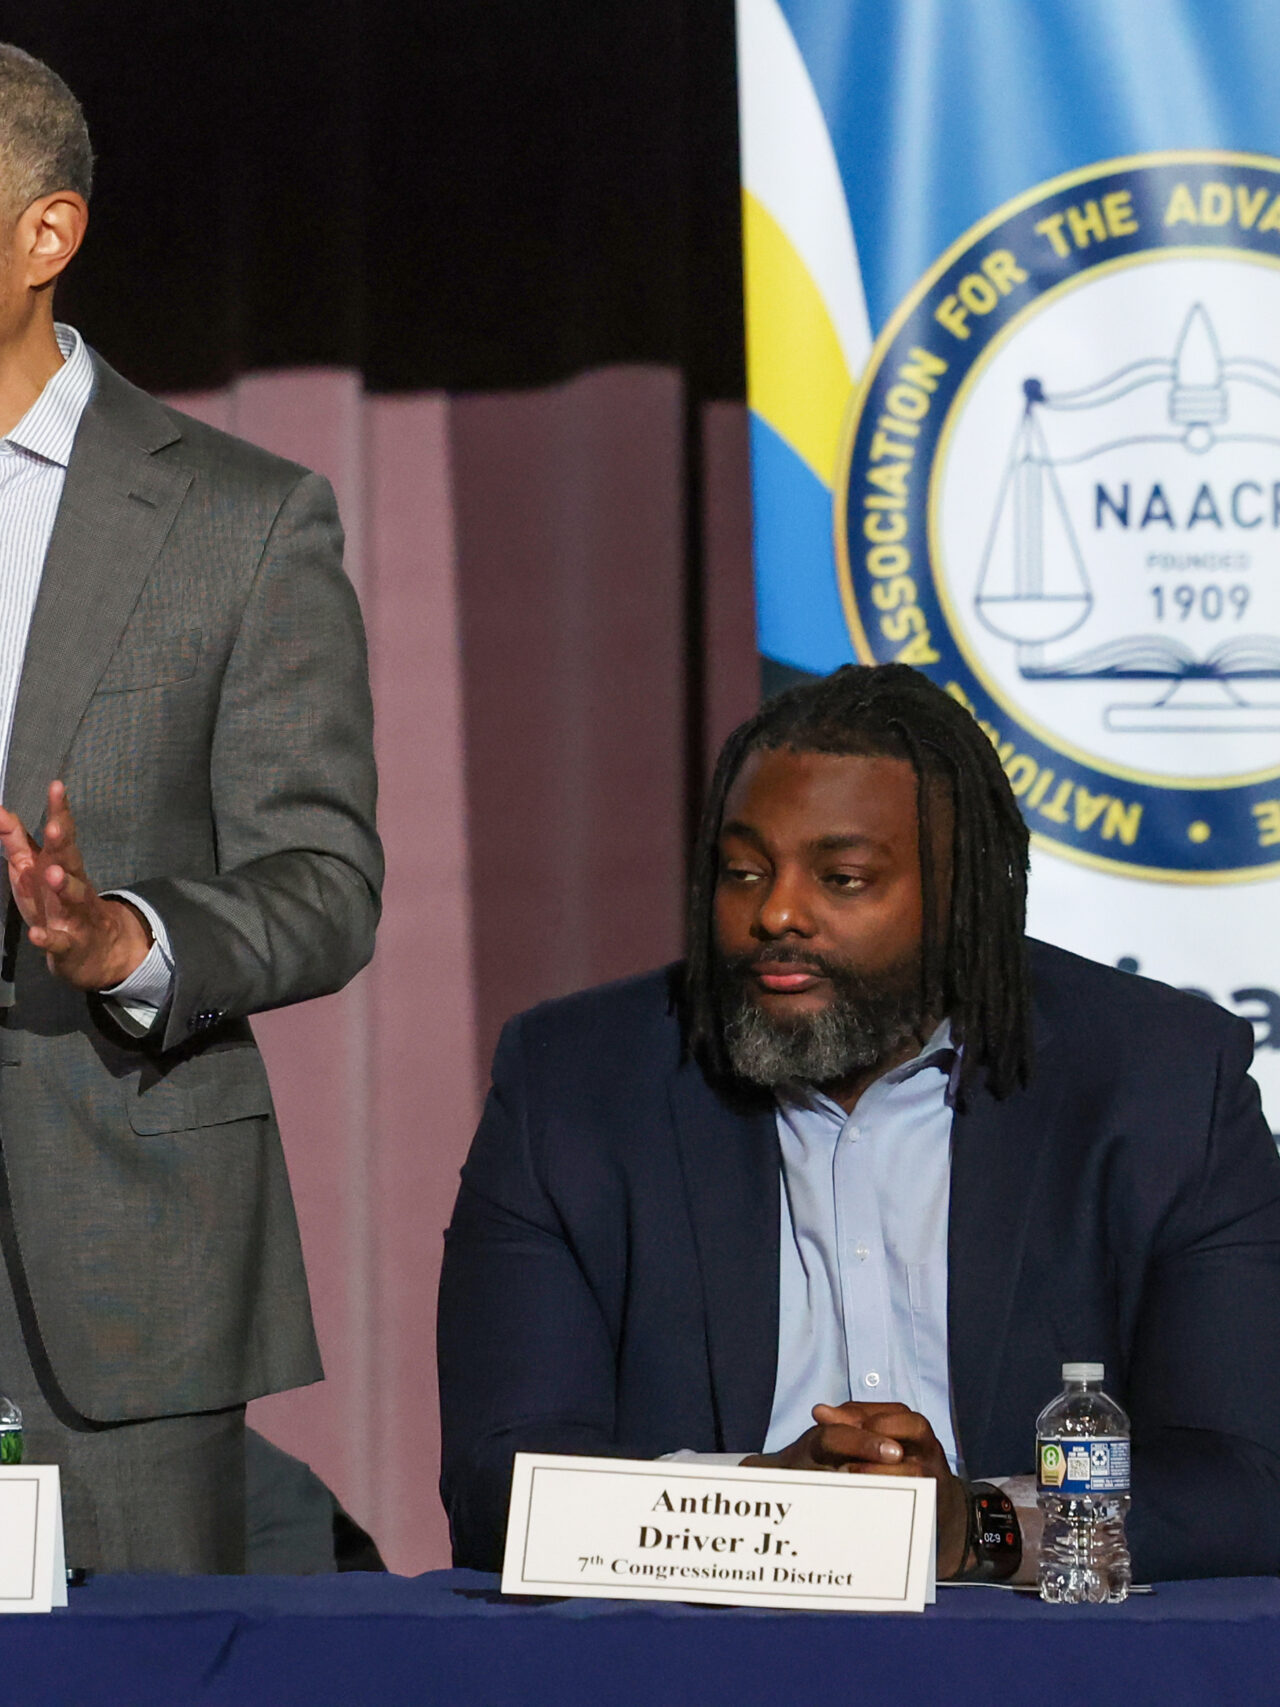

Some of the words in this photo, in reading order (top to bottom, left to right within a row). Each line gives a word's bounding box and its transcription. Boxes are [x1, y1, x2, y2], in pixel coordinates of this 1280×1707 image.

[864, 347, 948, 664] ASSOCIATION
[934, 249, 1027, 340] FOR
[1034, 191, 1139, 259] THE
[1095, 480, 1280, 530] NAAC
[1150, 584, 1251, 622] 1909
[652, 1490, 791, 1525] Anthony
[639, 1526, 744, 1553] Driver
[754, 1533, 797, 1556] Jr.
[611, 1559, 764, 1581] Congressional
[773, 1567, 852, 1586] District
